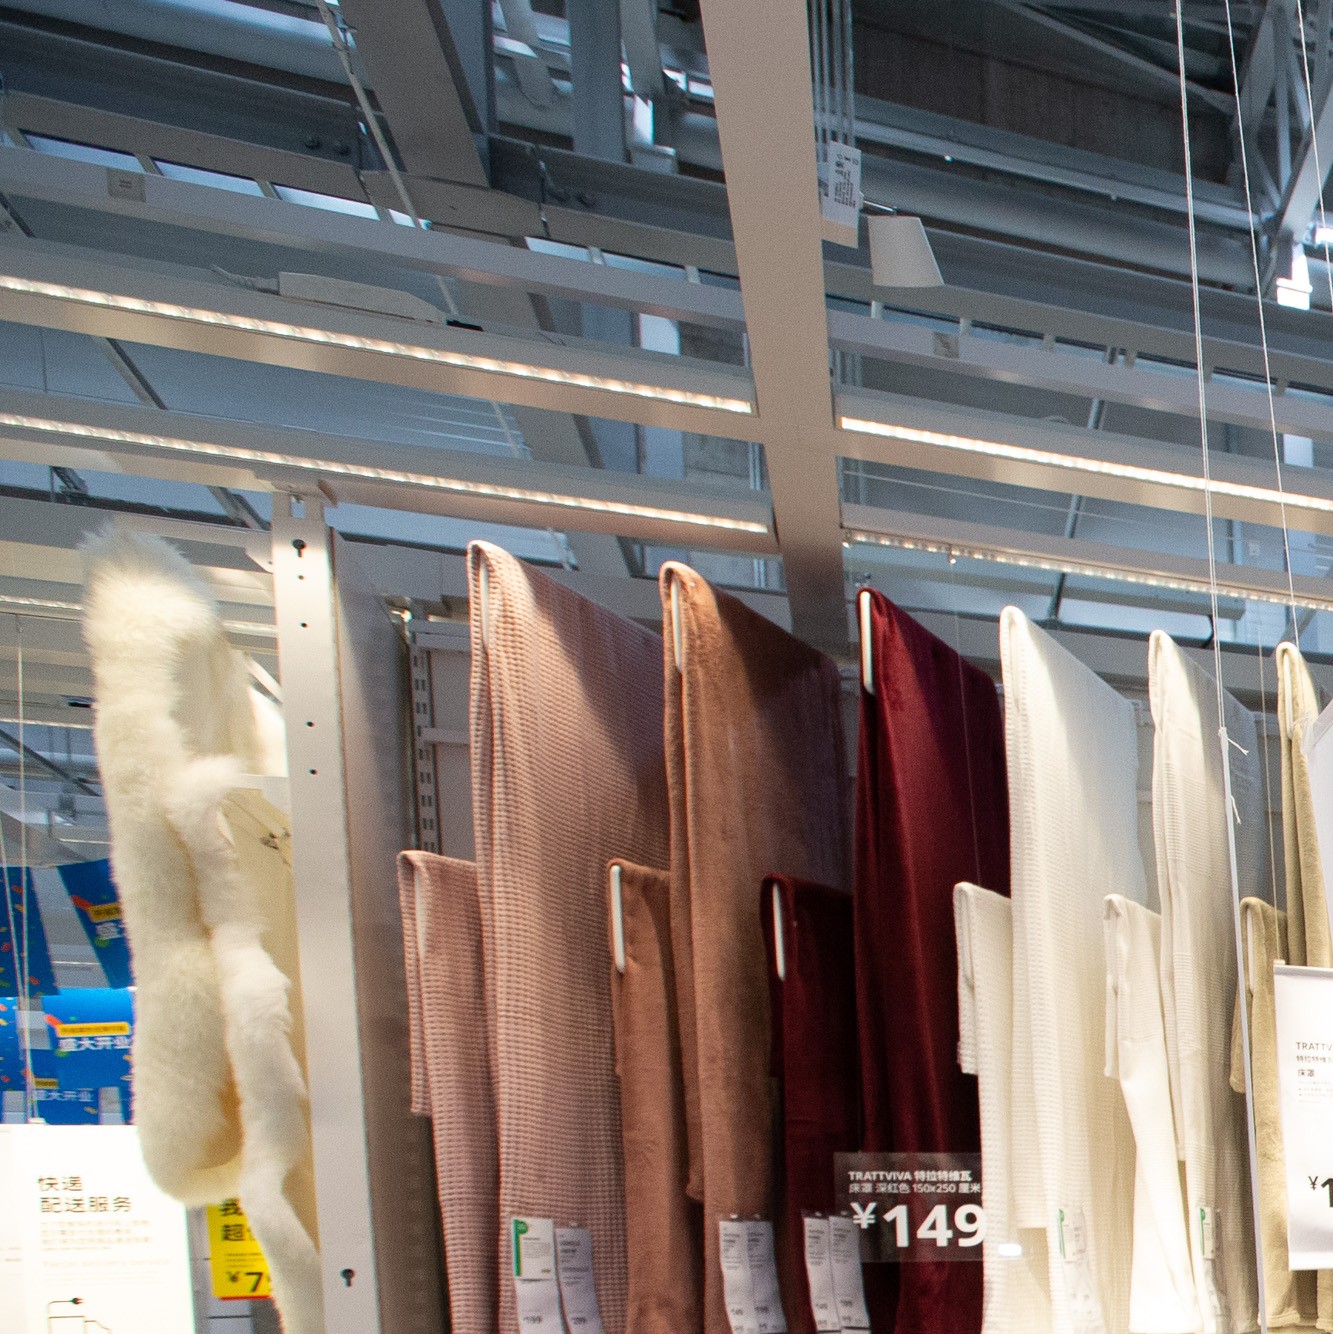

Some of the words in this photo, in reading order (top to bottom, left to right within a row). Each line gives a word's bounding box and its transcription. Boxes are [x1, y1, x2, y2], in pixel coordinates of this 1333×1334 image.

[848, 1171, 912, 1181] TRATTVIVA
[914, 1170, 973, 1182] 特拉特维瓦
[849, 1183, 873, 1194] 床罩
[876, 1183, 910, 1194] 深红色
[912, 1183, 956, 1193] 150x250
[958, 1183, 981, 1194] 厘米
[40, 1196, 131, 1213] 配送服务
[850, 1202, 987, 1248] ¥149
